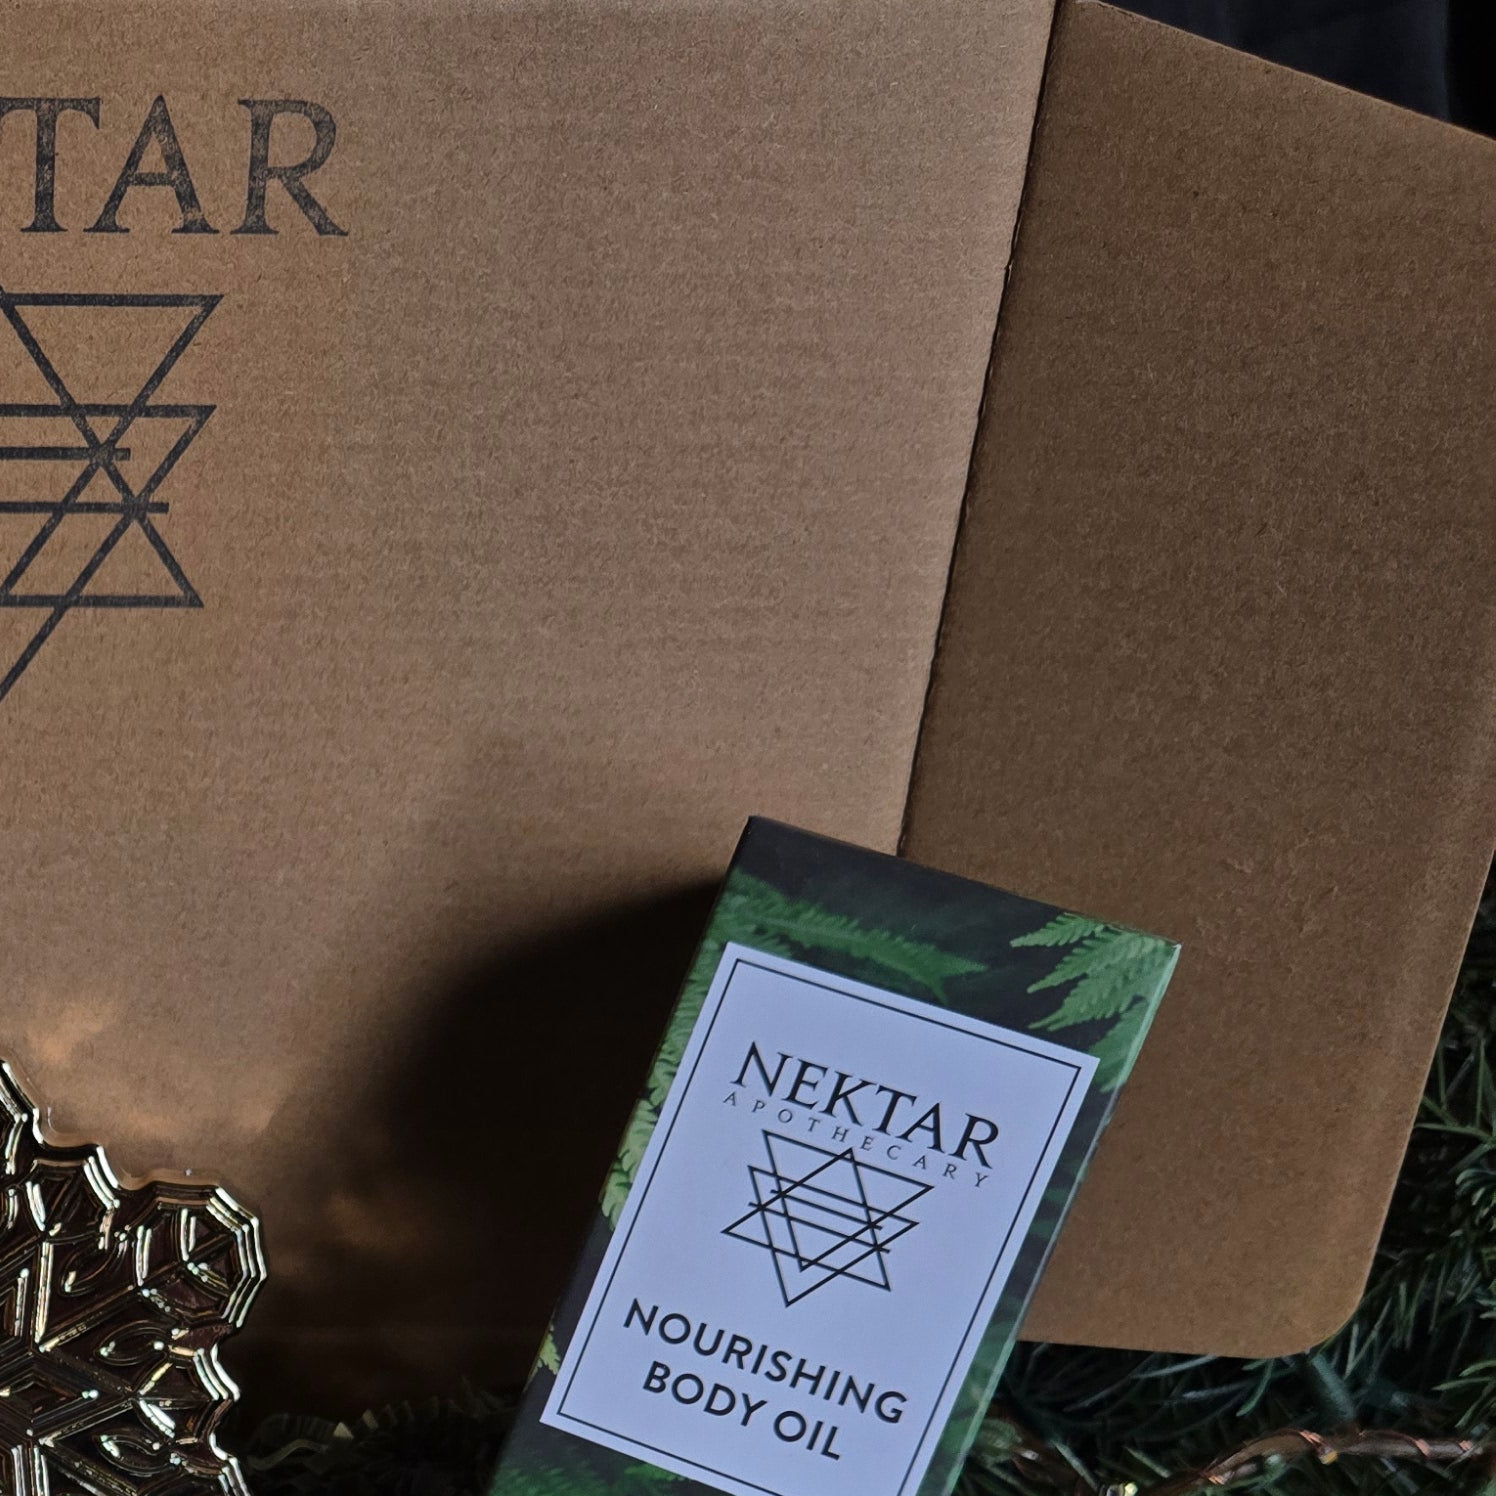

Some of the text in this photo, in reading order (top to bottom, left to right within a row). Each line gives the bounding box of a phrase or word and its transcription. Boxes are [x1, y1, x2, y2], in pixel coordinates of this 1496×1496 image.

[722, 1090, 991, 1189] APOTHECARY
[730, 1041, 1000, 1170] NEKTAR
[622, 1297, 908, 1425] NOURISHING
[642, 1360, 845, 1462] BODY OIL
